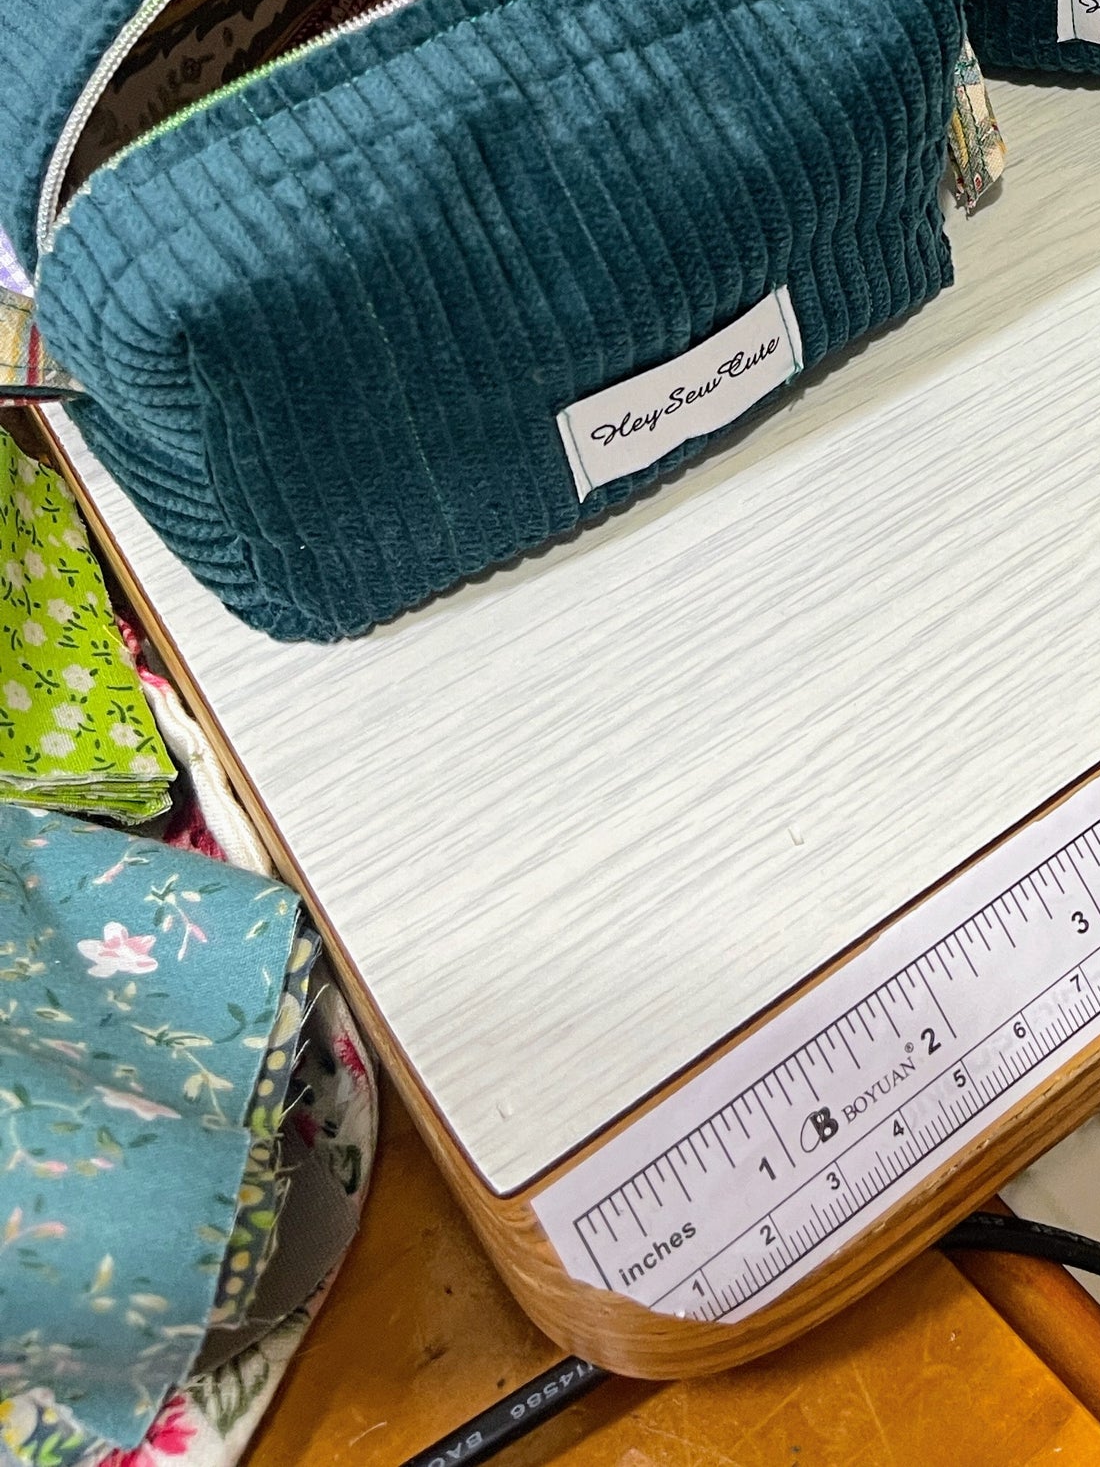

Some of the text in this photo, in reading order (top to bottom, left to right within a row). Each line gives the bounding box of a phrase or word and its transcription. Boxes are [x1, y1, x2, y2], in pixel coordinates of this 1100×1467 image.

[692, 1279, 705, 1297] 1
[759, 1224, 777, 1246] 2
[826, 1173, 841, 1192] 3
[892, 1119, 905, 1137] 4
[953, 1068, 967, 1088] 5
[1013, 1021, 1027, 1040] 6
[1070, 974, 1084, 993] 7
[759, 1157, 776, 1180] 1
[921, 1028, 941, 1055] 2
[1072, 911, 1089, 934] 3
[618, 1221, 697, 1287] inches
